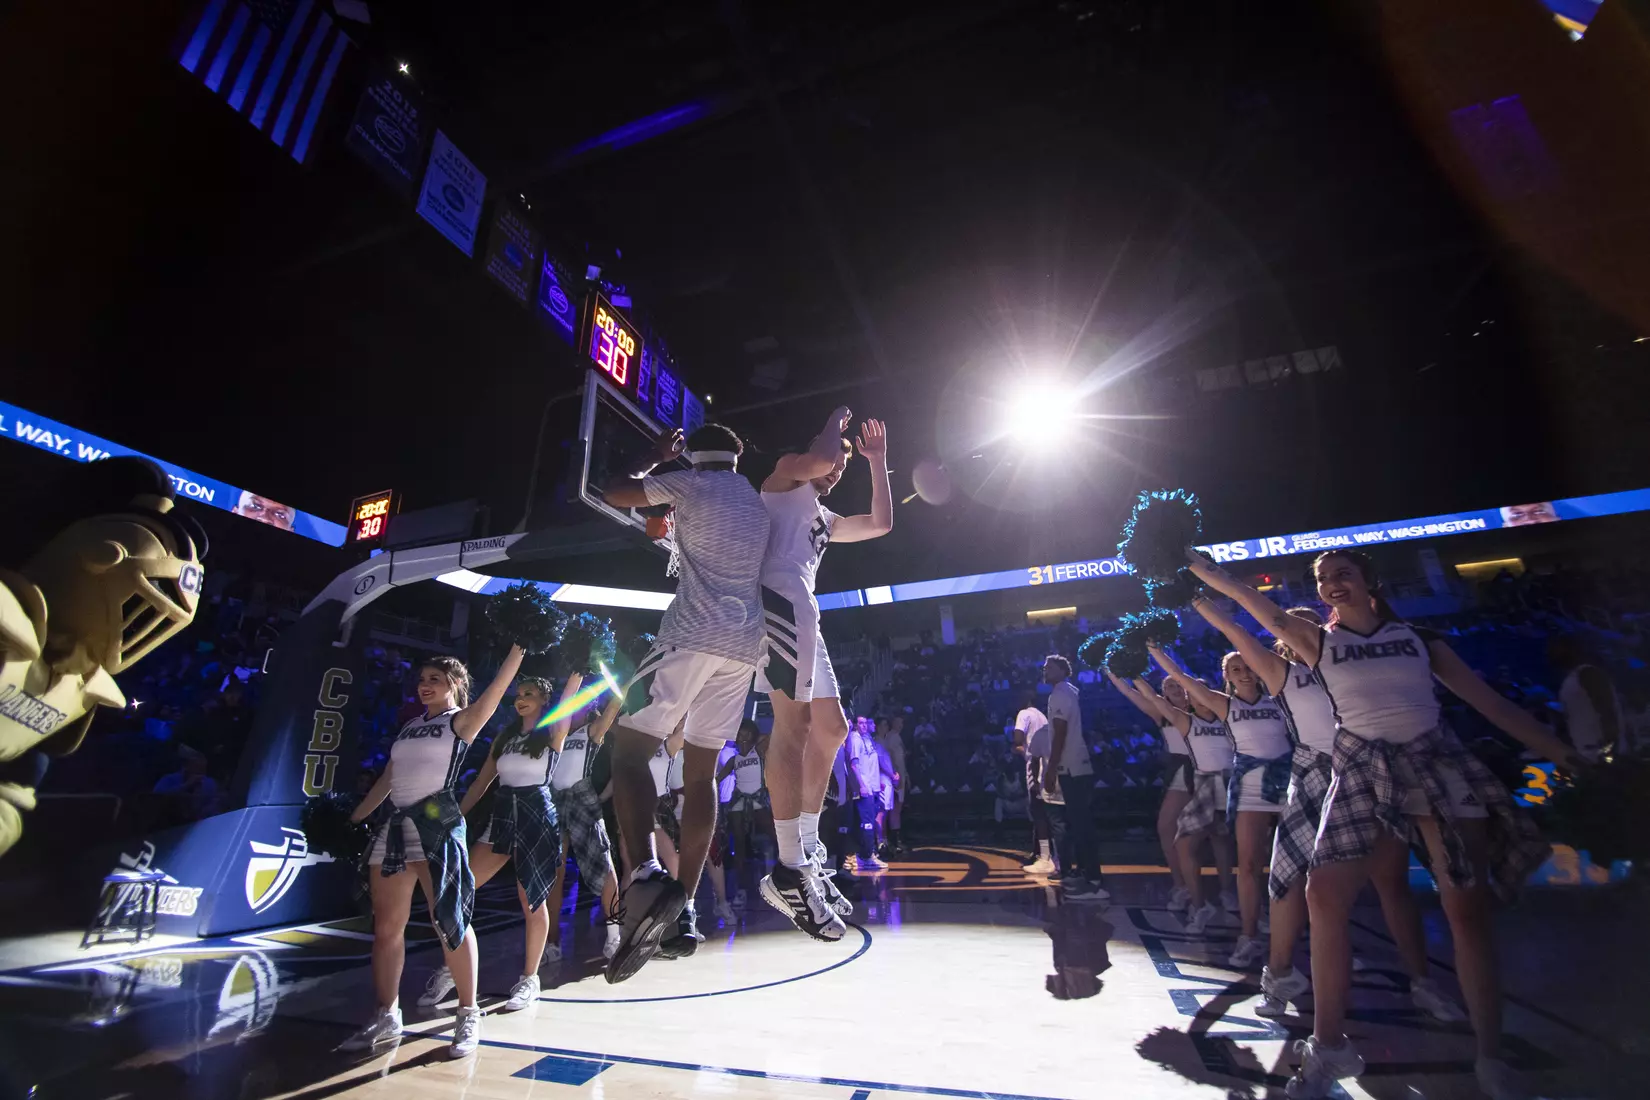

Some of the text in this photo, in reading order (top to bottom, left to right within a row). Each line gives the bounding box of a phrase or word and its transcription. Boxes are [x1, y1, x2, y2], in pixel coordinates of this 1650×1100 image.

[596, 307, 634, 356] 20:00
[597, 331, 628, 385] 30
[360, 516, 382, 538] 30
[1293, 534, 1351, 552] FEDERAL
[1387, 518, 1486, 539] WASHINGTON
[461, 536, 506, 553] SPALDING
[1027, 565, 1055, 586] 31
[1256, 536, 1296, 558] JR.
[1330, 639, 1421, 665] LANCERS
[302, 667, 353, 798] CBU
[1232, 708, 1281, 723] LANCERS
